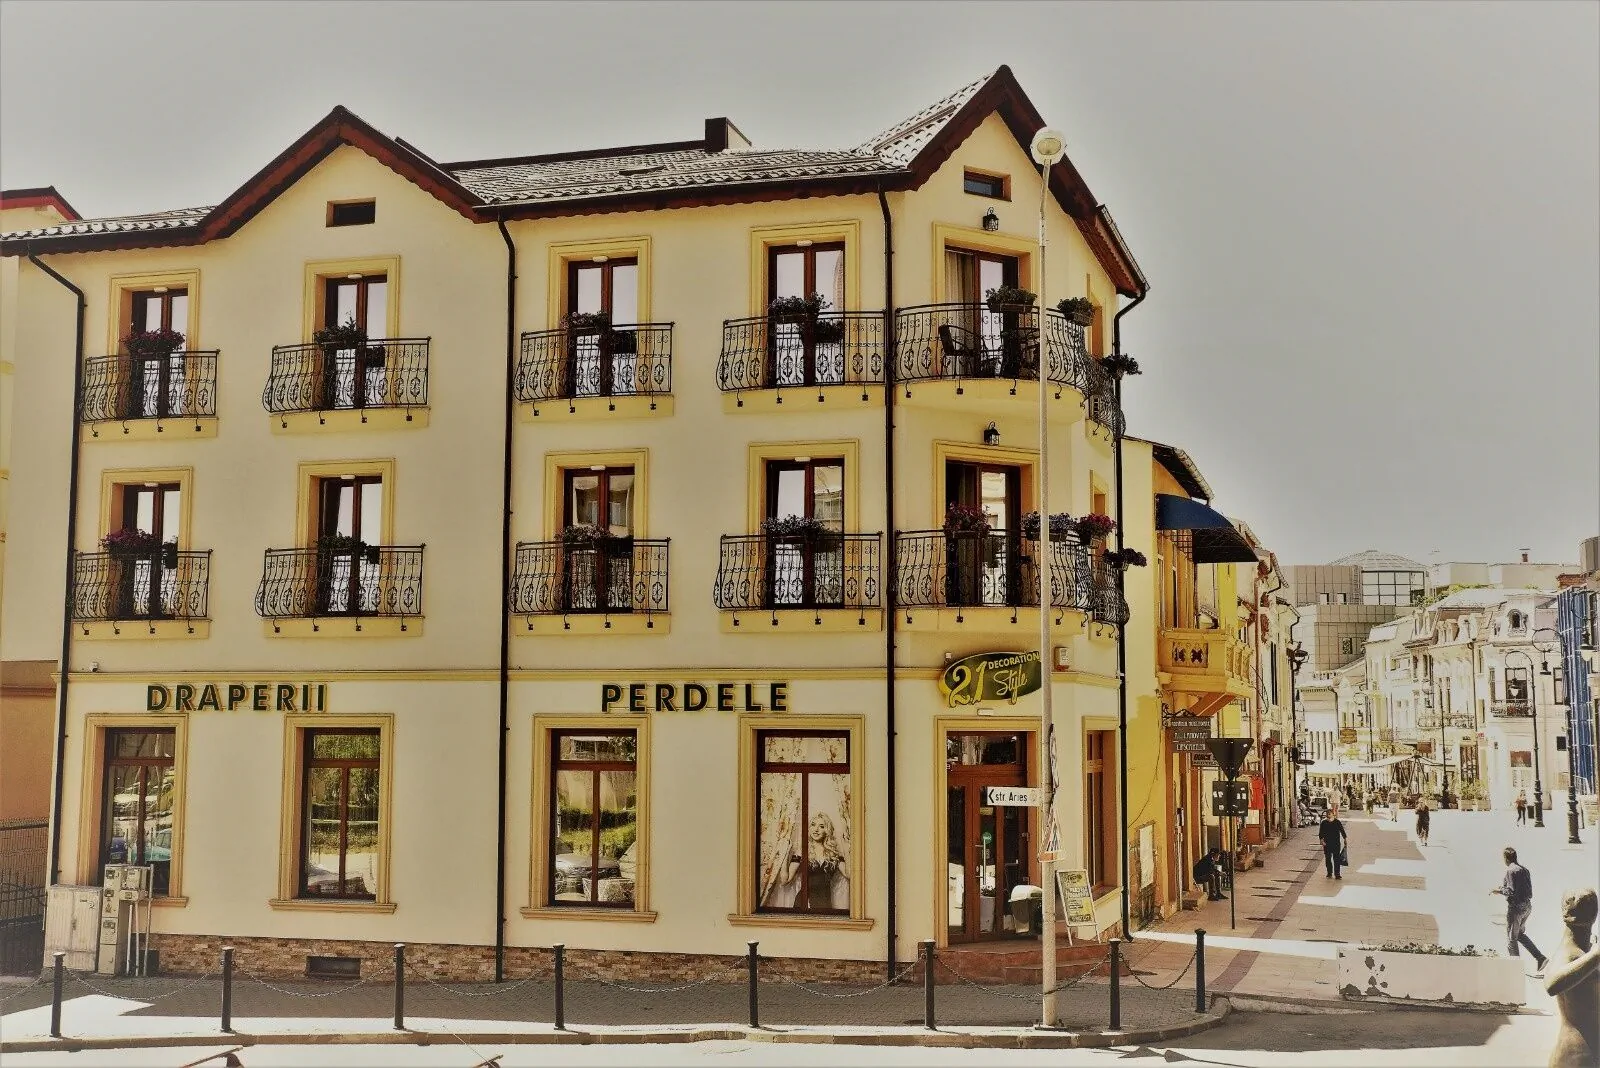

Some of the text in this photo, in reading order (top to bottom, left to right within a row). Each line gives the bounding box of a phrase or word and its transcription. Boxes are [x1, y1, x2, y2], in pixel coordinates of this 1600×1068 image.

[989, 652, 1041, 669] DECORATION
[147, 684, 327, 712] DRAPERII
[602, 682, 788, 712] PERDELE
[950, 660, 988, 708] 21
[993, 664, 1028, 705] Style
[995, 791, 1007, 802] str.
